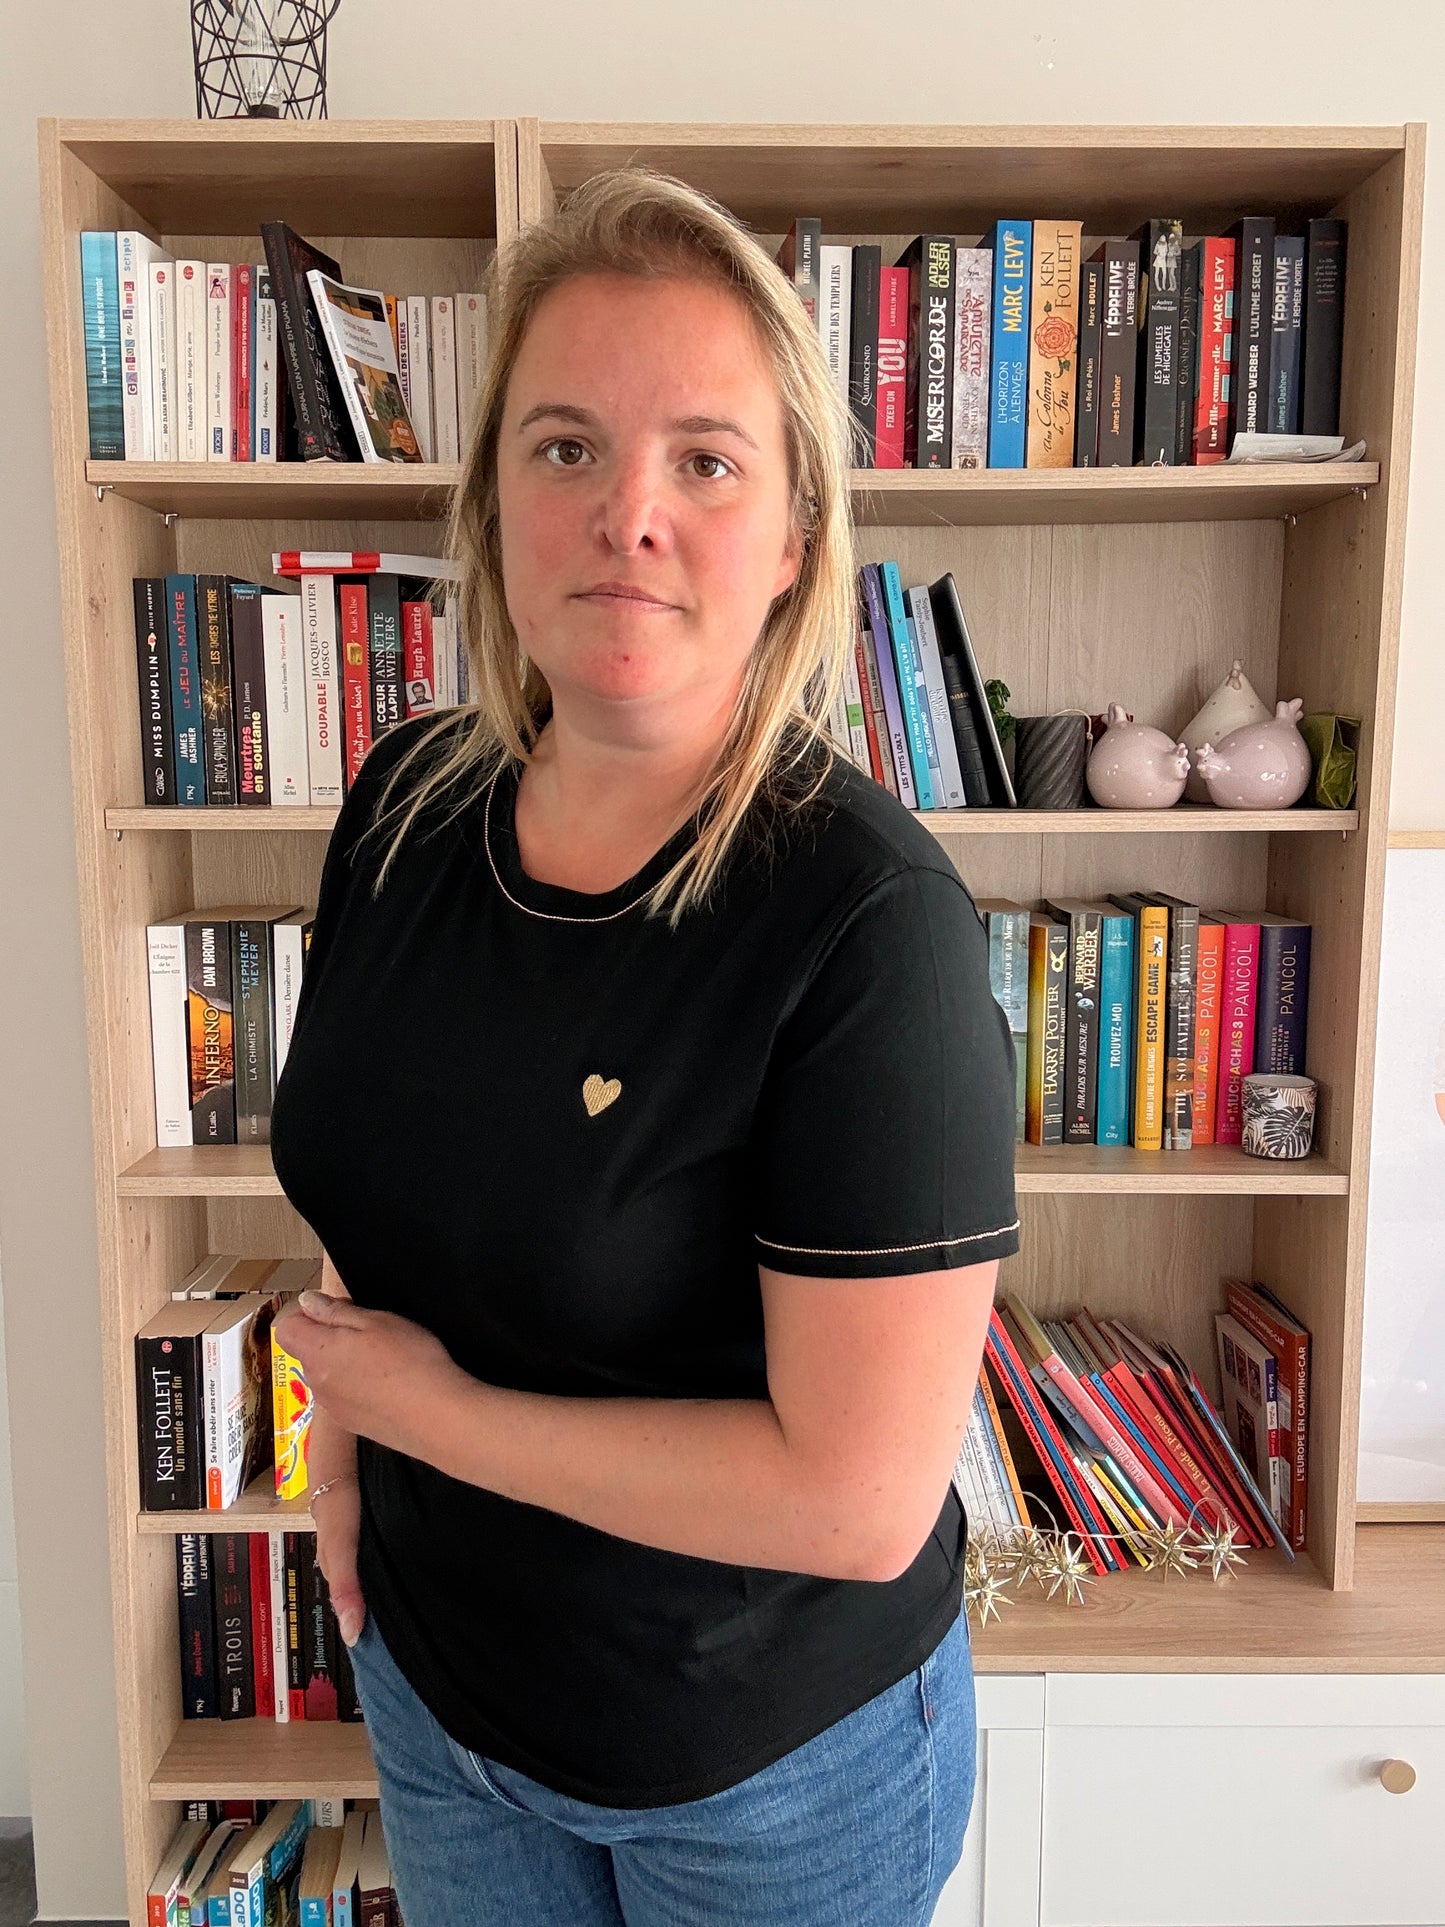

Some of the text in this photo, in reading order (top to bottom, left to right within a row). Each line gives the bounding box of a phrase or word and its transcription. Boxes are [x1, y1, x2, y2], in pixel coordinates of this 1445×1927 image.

[803, 234, 812, 284] MICHEL PLATINI
[829, 265, 841, 310] TEMPLIERS
[928, 242, 939, 282] ADLER
[939, 243, 950, 288] OLSEN
[1002, 237, 1024, 332] MARC LEVY
[1040, 251, 1054, 287] KEN
[1055, 229, 1074, 308] FOLLETT
[281, 301, 292, 329] PYJAMA
[830, 312, 840, 326] DES
[1087, 272, 1096, 326] Marc BOULET
[1105, 260, 1125, 337] L'ÉPREUVE
[1126, 261, 1136, 325] LA TERRE BRÛLÉE
[1213, 256, 1225, 332] MARC LEVY
[1250, 253, 1262, 338] L'ULTIME SECRET
[1272, 257, 1291, 332] L'ÉPREUVE
[1293, 257, 1303, 327] LE REMÈDE MORTEL
[289, 342, 301, 371] VAMPIRE
[295, 371, 304, 389] D'UN
[877, 337, 905, 428] FIXED ON YOU
[927, 296, 946, 444] MISERICORDE
[1154, 325, 1163, 384] LES JUMELLES
[1163, 325, 1172, 385] DE HIGHGATE
[1212, 365, 1220, 403] comme
[1213, 344, 1221, 364] elle
[301, 390, 310, 424] JOURNAL
[997, 361, 1009, 424] L'HORIZON
[1085, 358, 1094, 412] Le Roi de Pékin
[1111, 374, 1121, 435] James Dashner
[1209, 404, 1219, 425] fille
[1277, 370, 1288, 431] James Dashner
[261, 428, 270, 455] POCKET
[146, 583, 154, 610] MURPHY
[173, 591, 191, 709] LE JEU DU MAÎTRE
[308, 583, 321, 678] JACQUES-OLIVIER
[321, 641, 330, 677] BOSCO
[373, 612, 386, 678] ANNETTE
[385, 616, 396, 678] WIENERS
[412, 607, 426, 678] Hugh Laurie
[148, 656, 163, 758] MISS DUMPLIN
[317, 683, 329, 748] COUPABLE
[387, 684, 398, 719] LAPIN
[179, 732, 189, 758] JAMES
[188, 727, 197, 764] DASHNER
[213, 727, 227, 761] SPINDLER
[214, 762, 228, 783] ERICA
[241, 726, 254, 793] Meurtres
[251, 711, 264, 793] en soutane
[201, 928, 216, 987] DAN BROWN
[240, 930, 251, 999] STEPHENIE
[250, 944, 259, 986] MEYER
[1074, 935, 1086, 983] BERNARD
[1083, 929, 1098, 991] WERBER
[1177, 943, 1192, 993] FAMILY
[1200, 945, 1218, 1018] PANCOL
[1234, 943, 1252, 1017] PANCOL
[1280, 945, 1296, 1015] PANCOL
[1146, 962, 1160, 1043] ESCAPE GAME
[203, 1007, 221, 1085] INFERNO
[248, 1021, 258, 1081] LA CHIMISTE
[1044, 983, 1060, 1095] HARRY POTTER
[1110, 1003, 1122, 1068] TROUVEZ-MOI
[1176, 1002, 1190, 1081] SOCIALITE
[1077, 1022, 1088, 1110] PARADIS SUR MESURE
[1195, 1028, 1209, 1111] MUCHACHAS
[1227, 1021, 1244, 1113] MUCHACHAS 3
[1145, 1101, 1154, 1121] GRAND
[1174, 1089, 1186, 1117] THE
[278, 1354, 287, 1388] HUON
[152, 1367, 174, 1482] KEN FOLLETT
[173, 1376, 186, 1472] Un monde sans fin
[209, 1415, 217, 1435] obéir
[1296, 1346, 1306, 1482] L'EUROPE EN CAMPING-CAR
[209, 1437, 218, 1454] faire
[210, 1455, 217, 1463] Se
[1152, 1412, 1211, 1493] La Bande à Picsou
[182, 1535, 197, 1597] L'ÉPREUVE
[272, 1559, 280, 1582] Jacques
[225, 1617, 243, 1675] TROIS
[275, 1628, 283, 1653] Devenir
[289, 1611, 297, 1622] SUR
